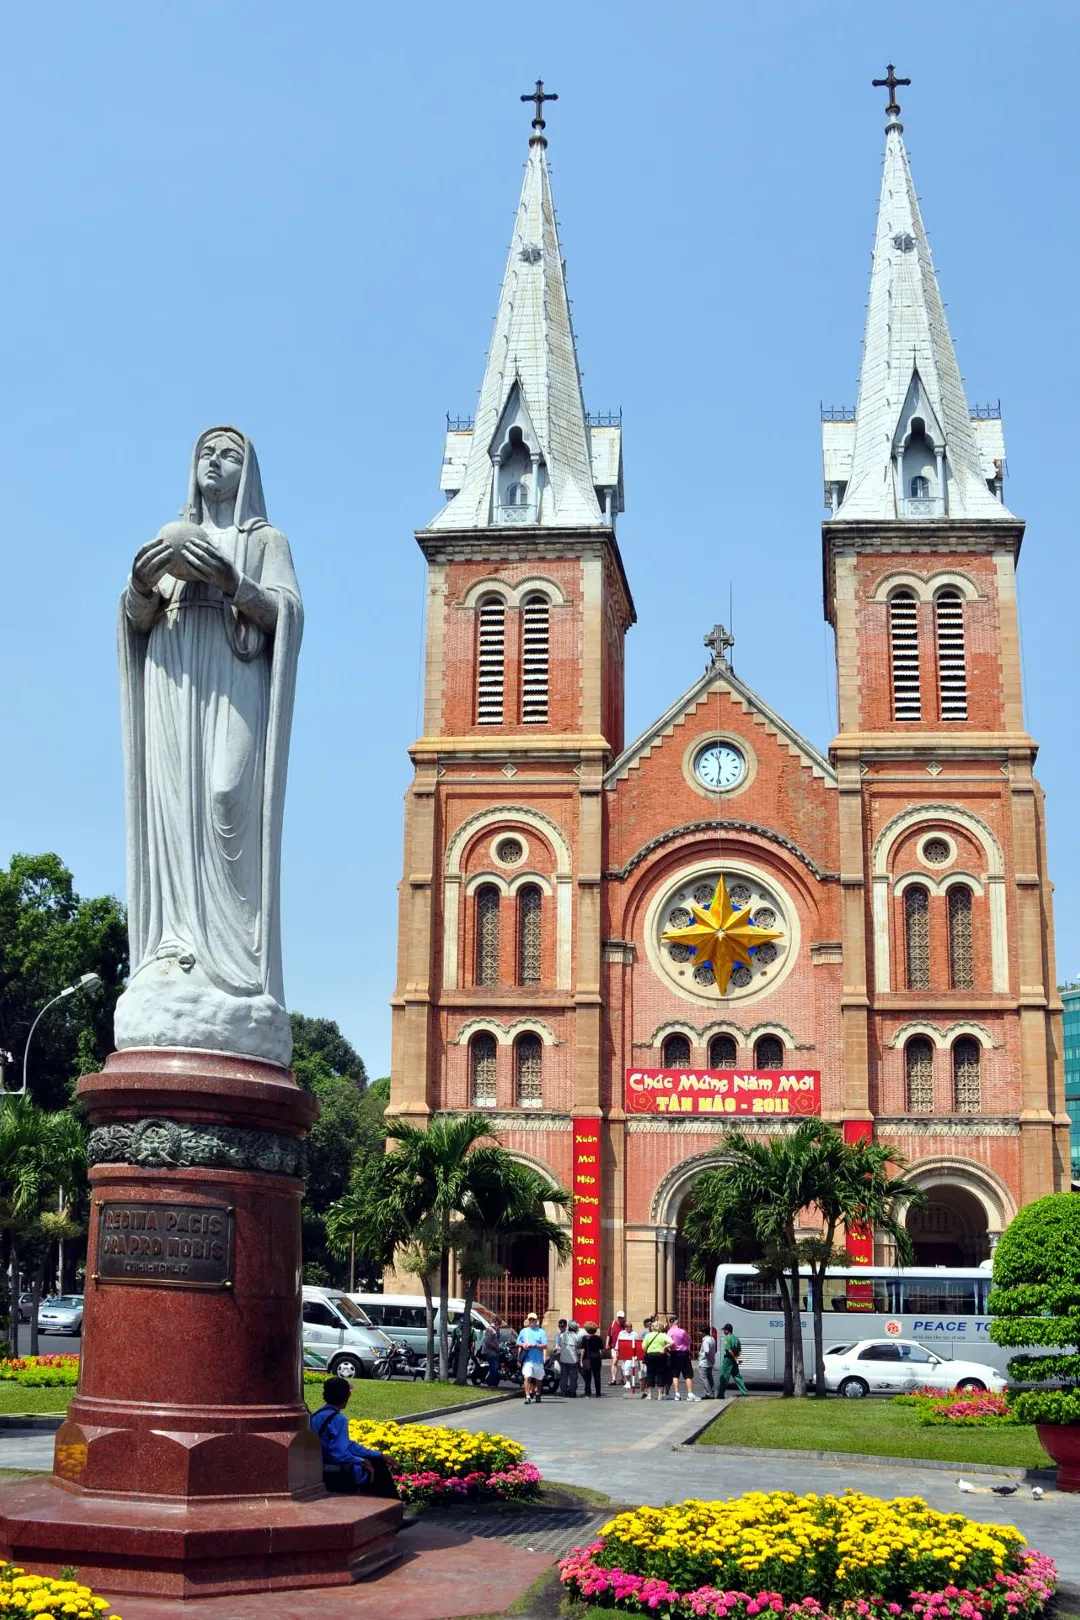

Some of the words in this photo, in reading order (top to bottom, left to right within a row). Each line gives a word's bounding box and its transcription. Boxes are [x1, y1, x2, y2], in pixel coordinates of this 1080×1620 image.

[629, 1073, 673, 1092] Chúc
[678, 1073, 729, 1094] Mừng
[733, 1074, 773, 1094] Năm
[778, 1075, 815, 1094] Mới
[656, 1093, 693, 1112] TÂN
[752, 1097, 790, 1113] 2011
[105, 1210, 158, 1231] REGINA
[165, 1211, 223, 1236] PACIS
[102, 1235, 126, 1255] ORA
[129, 1235, 163, 1256] PRO
[167, 1237, 224, 1261] NOBIS
[577, 1236, 595, 1245] Hoa
[913, 1321, 968, 1331] PEACE
